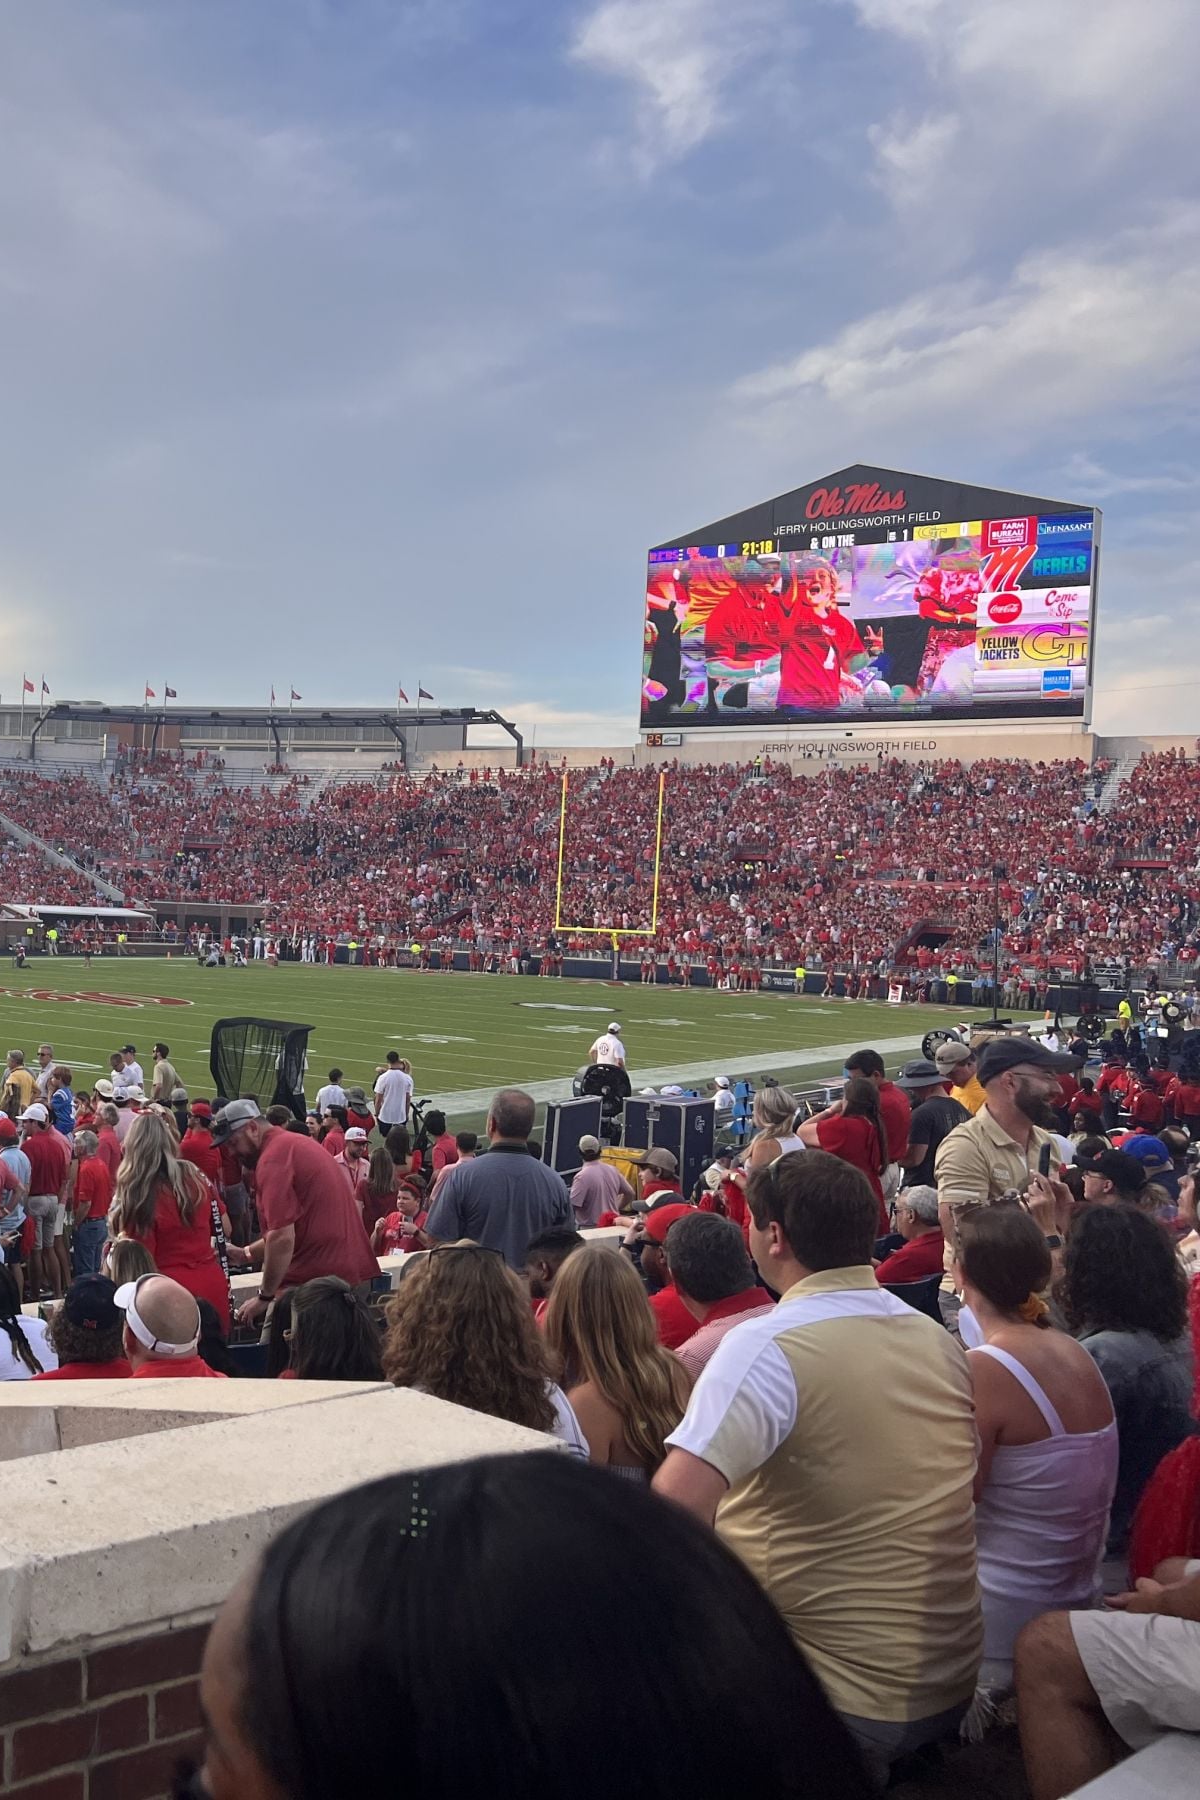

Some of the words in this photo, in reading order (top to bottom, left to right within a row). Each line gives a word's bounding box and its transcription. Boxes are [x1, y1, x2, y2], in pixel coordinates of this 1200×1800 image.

[805, 487, 844, 519] Ole
[845, 482, 907, 514] Miss
[773, 524, 807, 536] JERRY
[810, 513, 906, 532] HOLLINGSWORTH
[908, 511, 941, 523] FIELD
[1002, 522, 1025, 530] FARM
[1046, 523, 1093, 533] RENASANT
[992, 529, 1024, 538] BUREAU
[742, 540, 773, 555] 21:18
[1033, 555, 1087, 577] REBELS
[981, 636, 1019, 650] YELLOW
[980, 648, 1020, 661] JACKETS
[647, 735, 661, 745] 25
[760, 743, 794, 753] JERRY
[798, 741, 900, 752] HOLLINGSWORTH
[903, 741, 937, 750] FIELD
[211, 1199, 222, 1225] MISS
